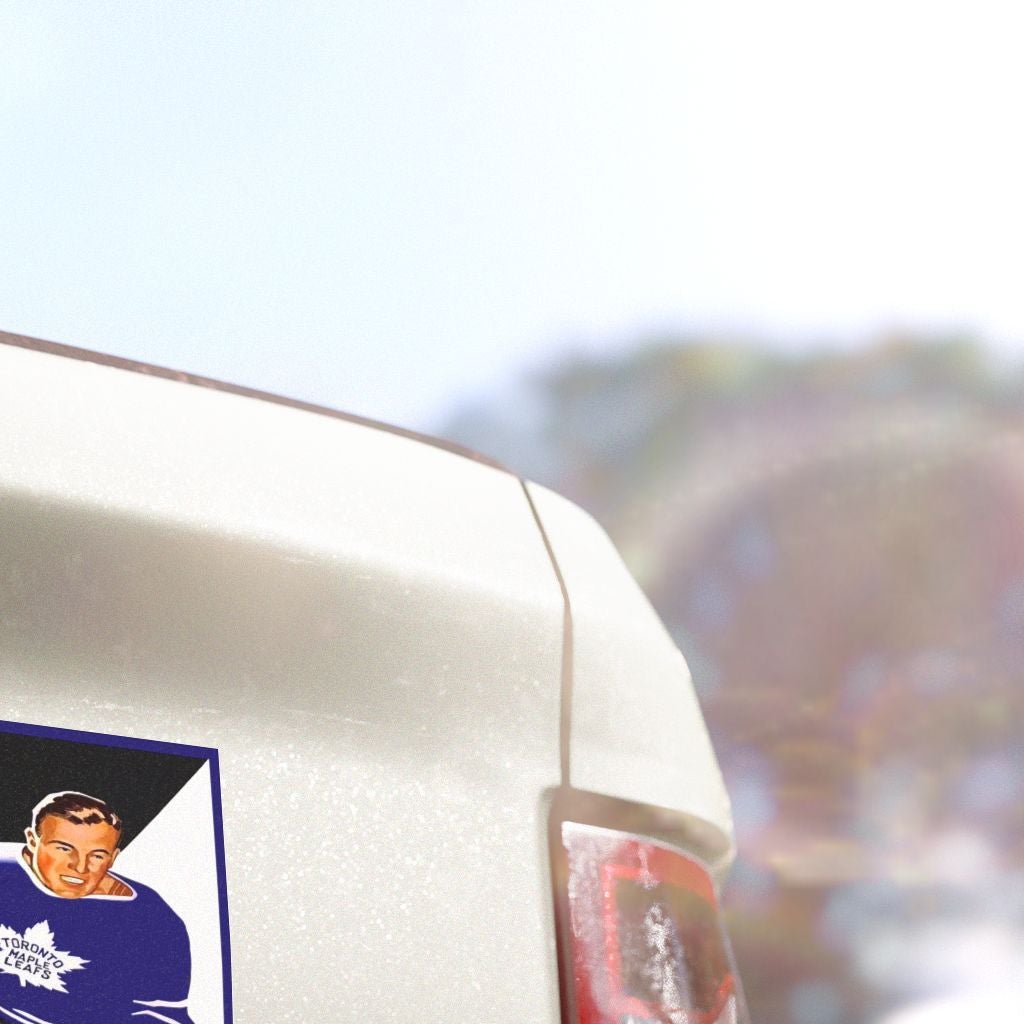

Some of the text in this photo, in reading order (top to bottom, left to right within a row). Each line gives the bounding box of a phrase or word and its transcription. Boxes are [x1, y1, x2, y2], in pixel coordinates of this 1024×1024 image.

[1, 937, 64, 968] TORONTO
[8, 949, 50, 968] MAPLE
[4, 957, 52, 980] LEAFS
